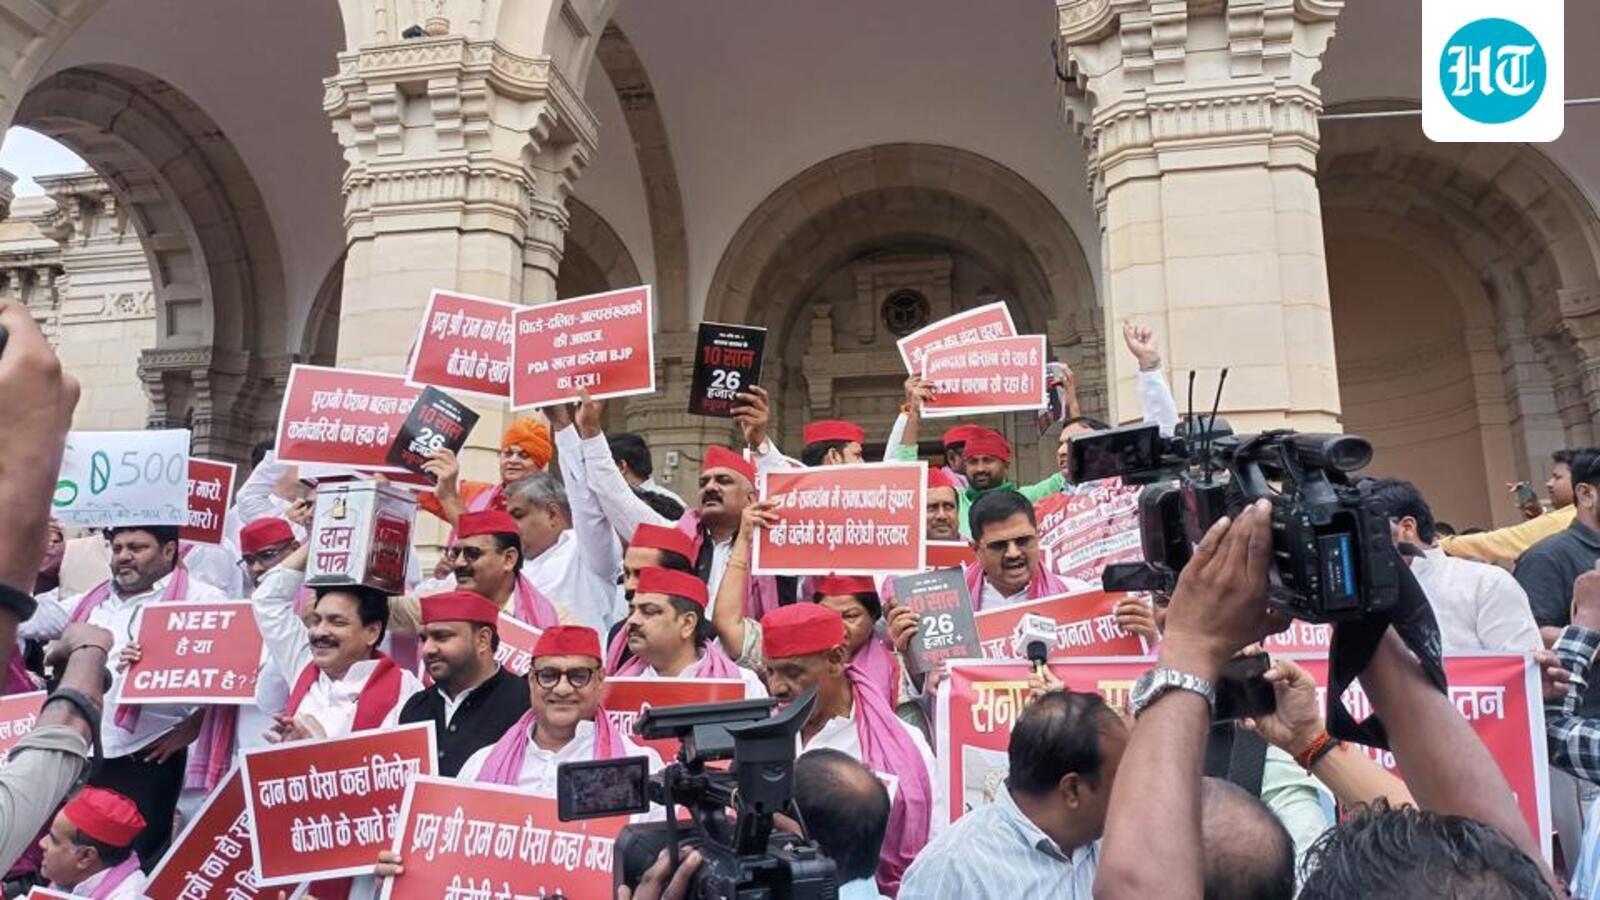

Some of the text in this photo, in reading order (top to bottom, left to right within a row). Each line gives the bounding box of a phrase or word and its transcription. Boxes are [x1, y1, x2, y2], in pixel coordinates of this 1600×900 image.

[528, 361, 549, 374] PDA
[610, 347, 633, 361] BJP
[703, 345, 721, 366] 10
[711, 369, 741, 390] 26
[415, 427, 446, 449] 26
[320, 527, 355, 549] दान
[316, 551, 351, 574] पात्र
[167, 611, 236, 630] NEET
[922, 614, 954, 637] 26
[175, 637, 213, 656] है या
[134, 668, 219, 690] CHEAT
[258, 779, 287, 808] दान
[288, 776, 309, 802] का
[309, 765, 338, 800] पैसा
[291, 814, 334, 853] बीजेपी
[335, 812, 351, 846] के
[353, 807, 384, 845] खाते
[411, 812, 443, 862] प्रभु
[439, 806, 464, 854] श्री
[464, 818, 496, 857] राम
[494, 822, 520, 860] का
[519, 815, 553, 865] पैसा
